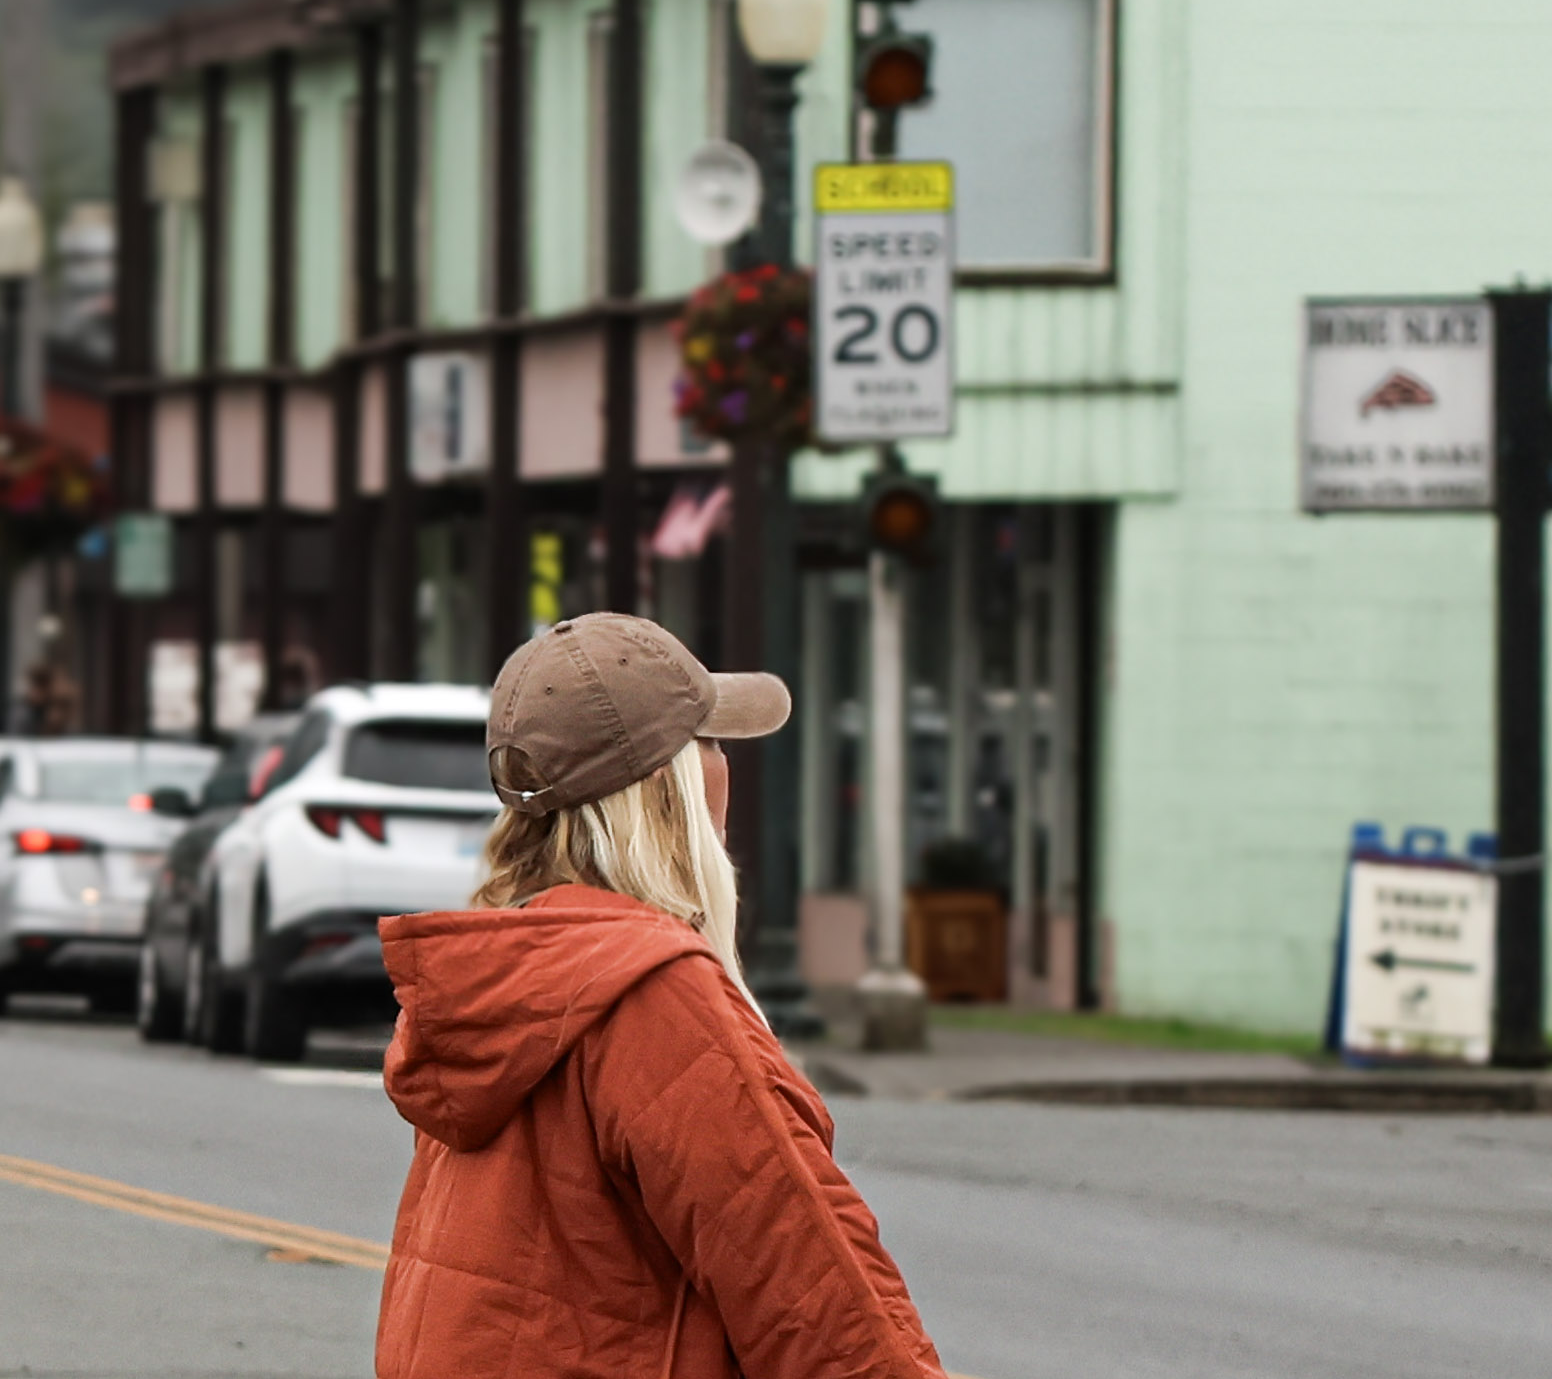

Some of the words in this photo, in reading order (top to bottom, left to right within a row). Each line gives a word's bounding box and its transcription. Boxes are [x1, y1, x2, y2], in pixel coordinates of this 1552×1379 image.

[828, 177, 943, 201] SCHOOL
[830, 232, 942, 260] SPEED
[838, 269, 928, 295] LIMIT
[833, 302, 940, 364] 20
